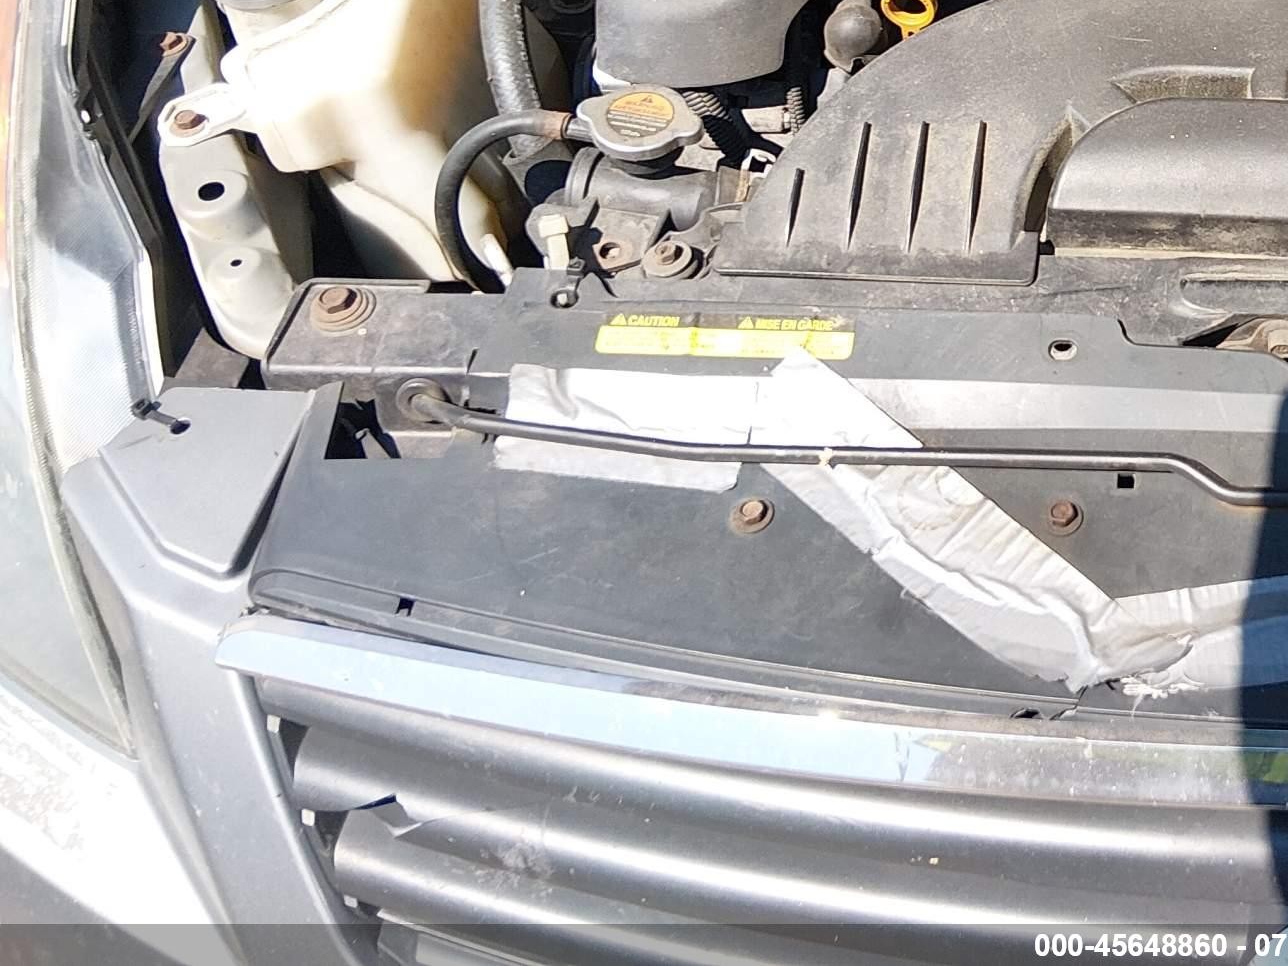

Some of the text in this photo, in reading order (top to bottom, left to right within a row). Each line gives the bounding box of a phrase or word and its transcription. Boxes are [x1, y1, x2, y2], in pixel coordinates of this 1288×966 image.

[628, 315, 680, 327] CAUTION
[755, 318, 834, 331] MISE EN GARDE
